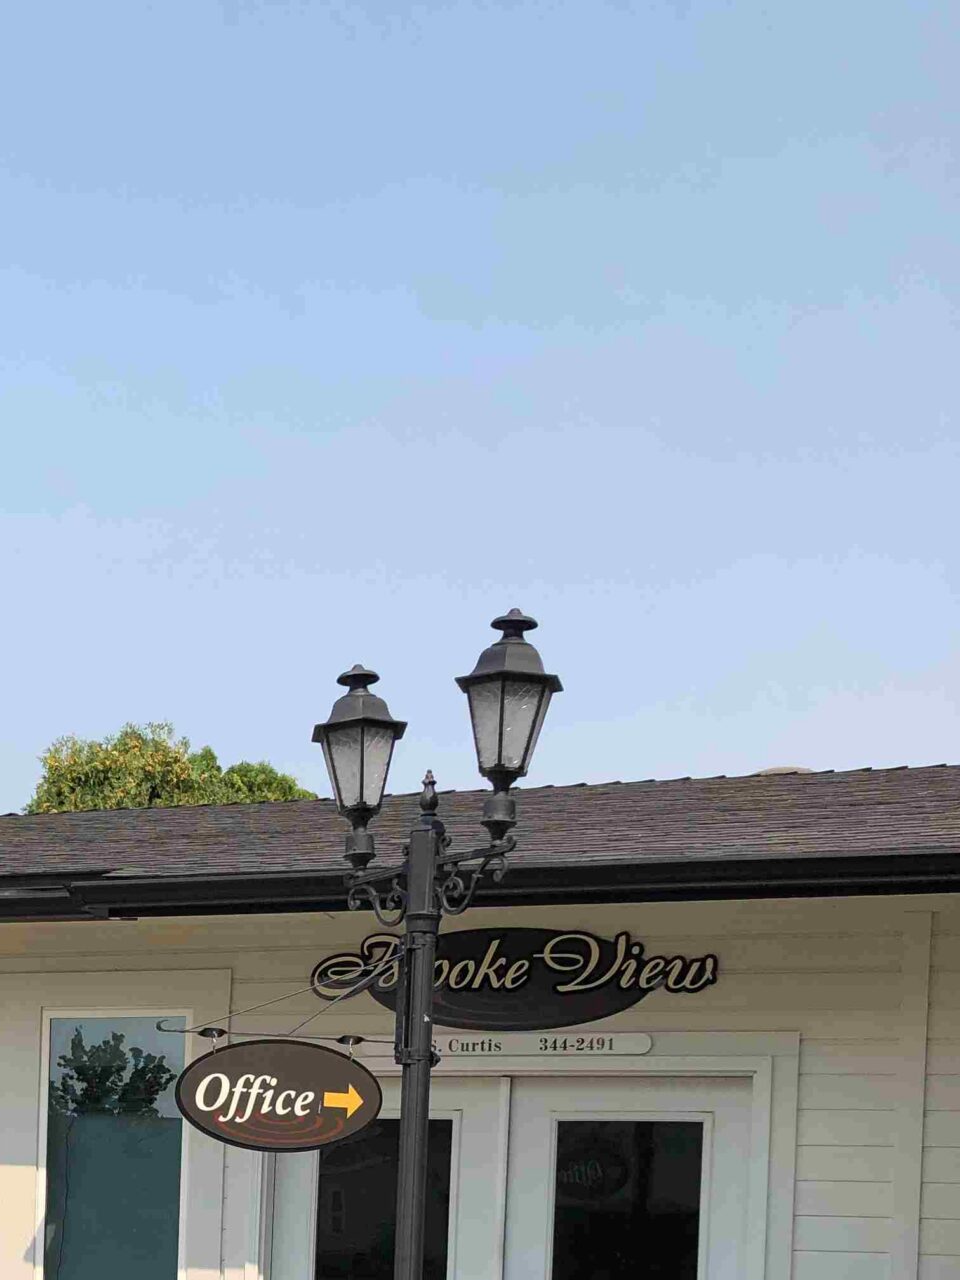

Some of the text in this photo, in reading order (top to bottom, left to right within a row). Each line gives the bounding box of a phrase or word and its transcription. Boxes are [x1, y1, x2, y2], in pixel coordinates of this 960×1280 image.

[313, 934, 714, 998] Booke View
[448, 1038, 502, 1053] Curtis
[539, 1037, 615, 1052] 344-2491
[195, 1072, 315, 1124] Office
